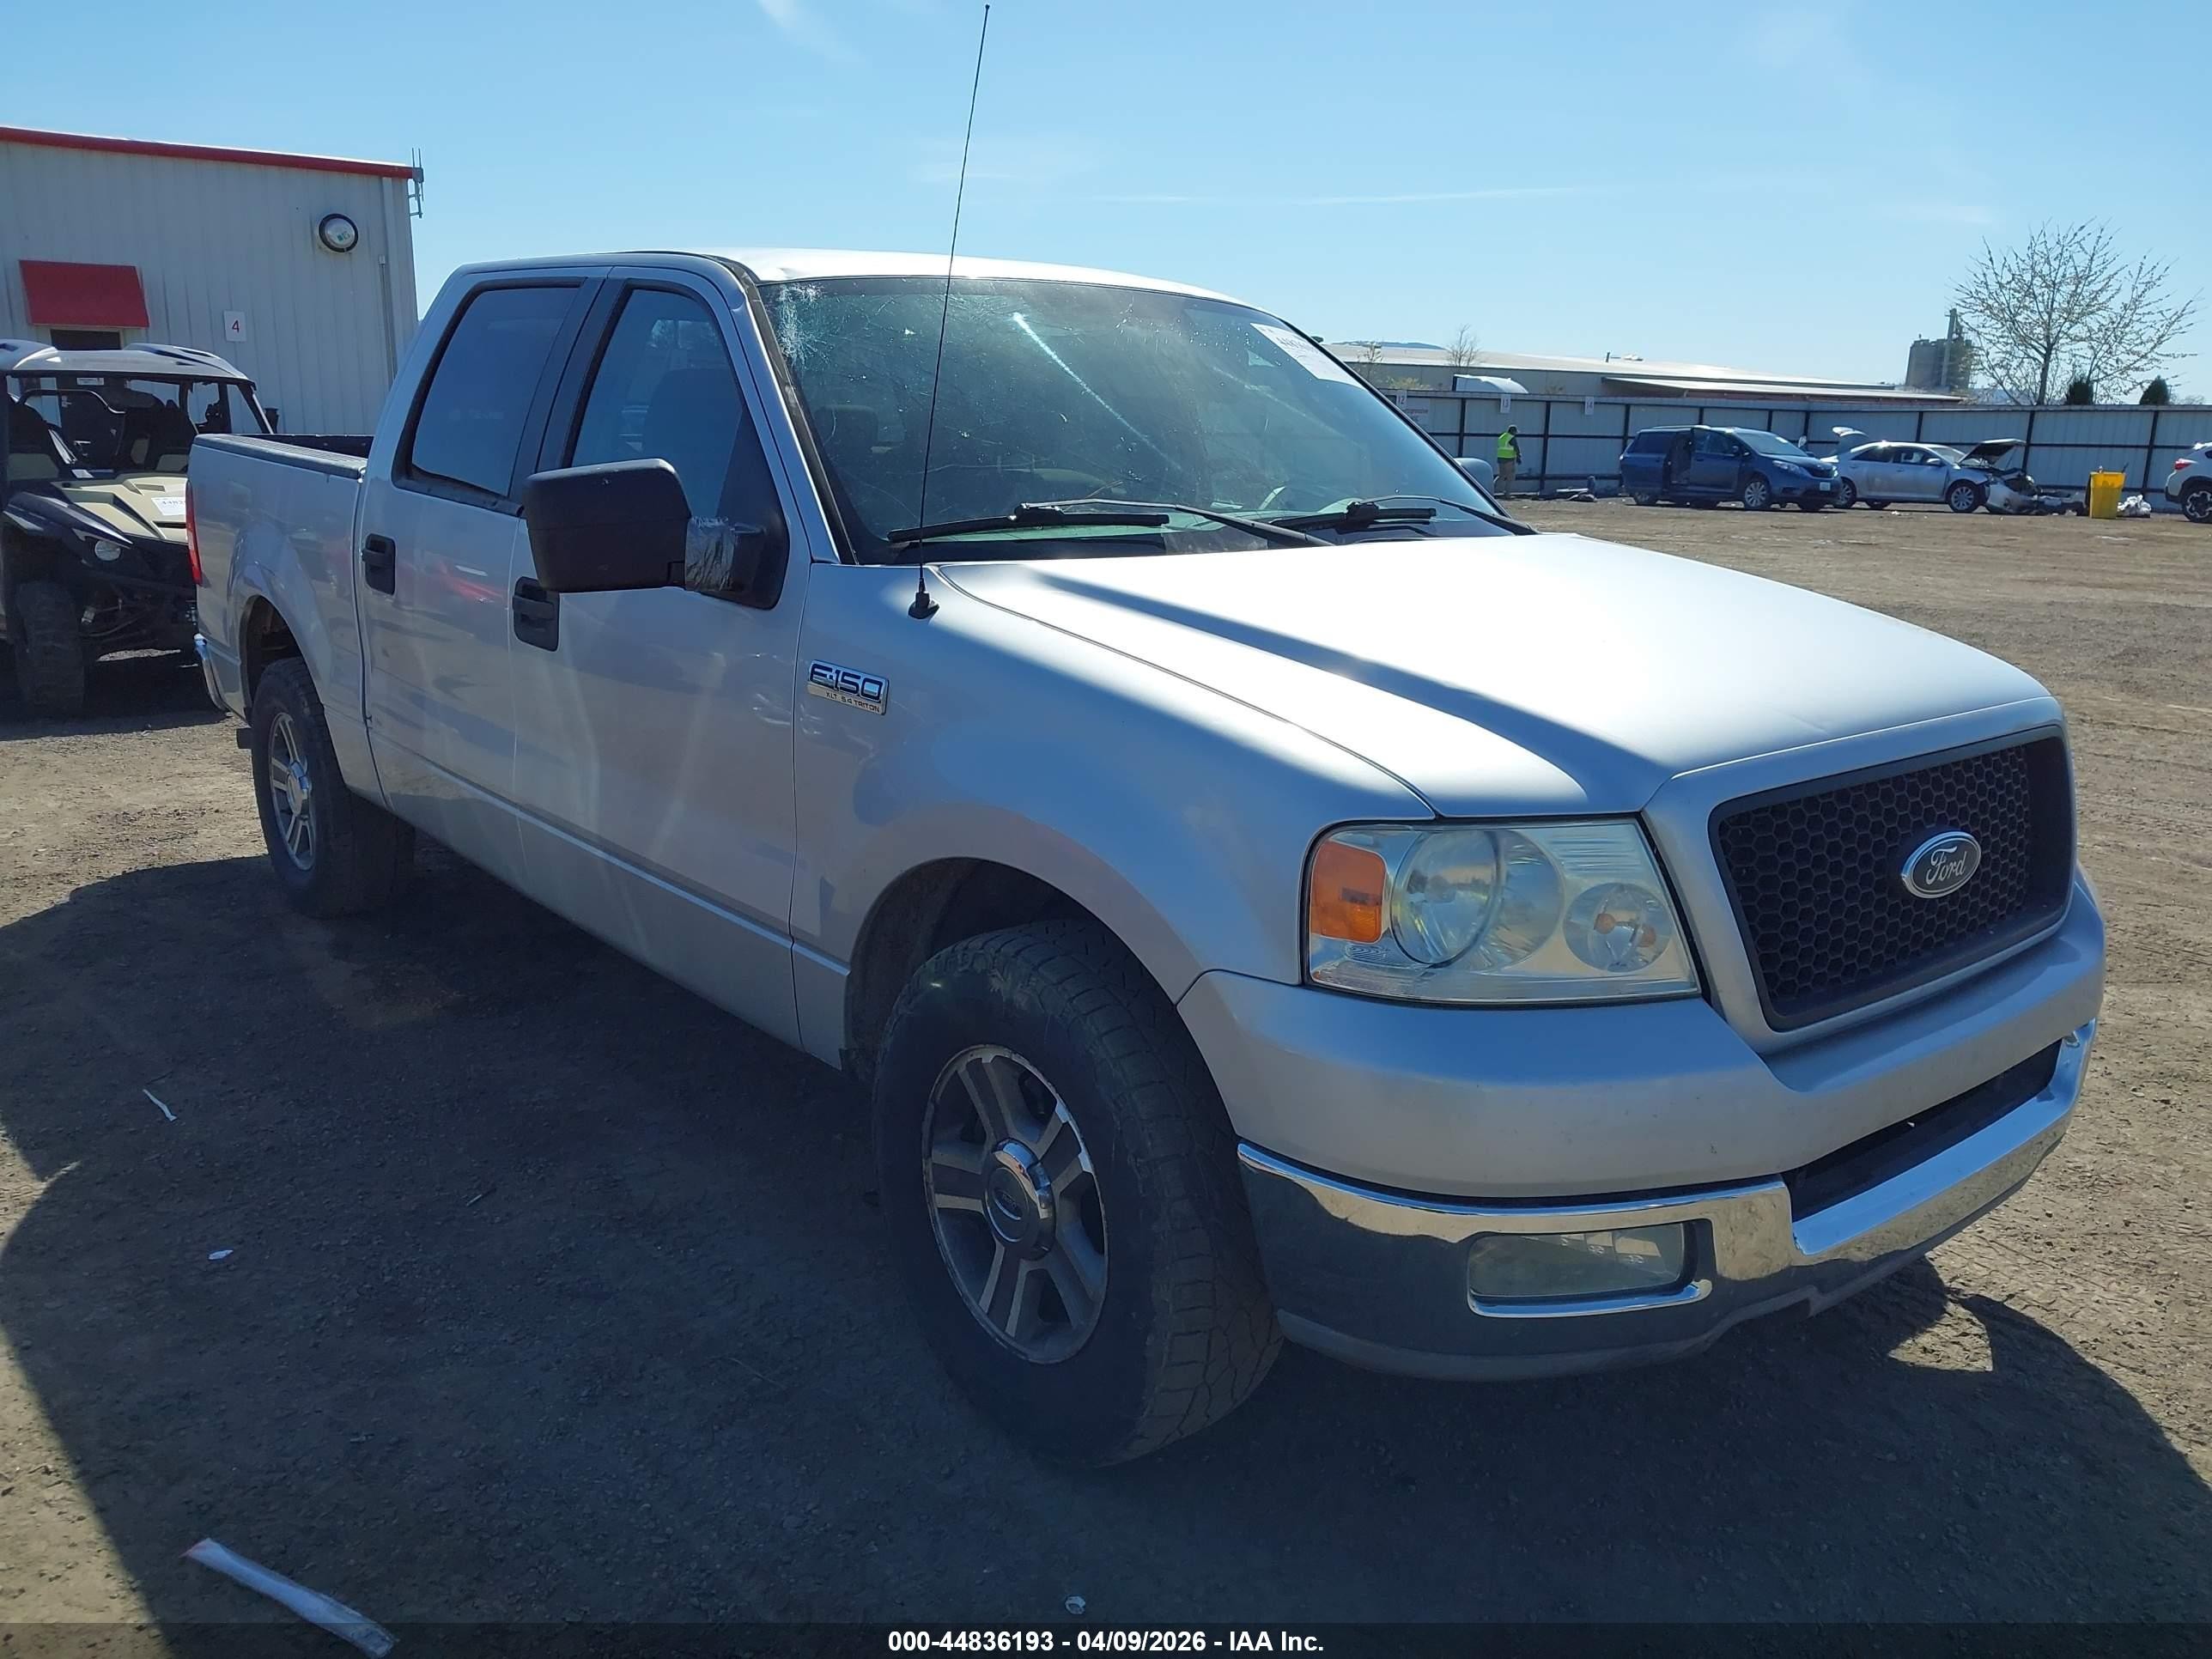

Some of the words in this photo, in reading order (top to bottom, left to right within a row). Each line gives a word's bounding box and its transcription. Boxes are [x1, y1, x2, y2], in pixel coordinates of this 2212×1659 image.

[232, 319, 240, 333] 4
[825, 691, 838, 700] XLT
[854, 700, 880, 713] TRITON
[1925, 845, 1967, 885] Ford
